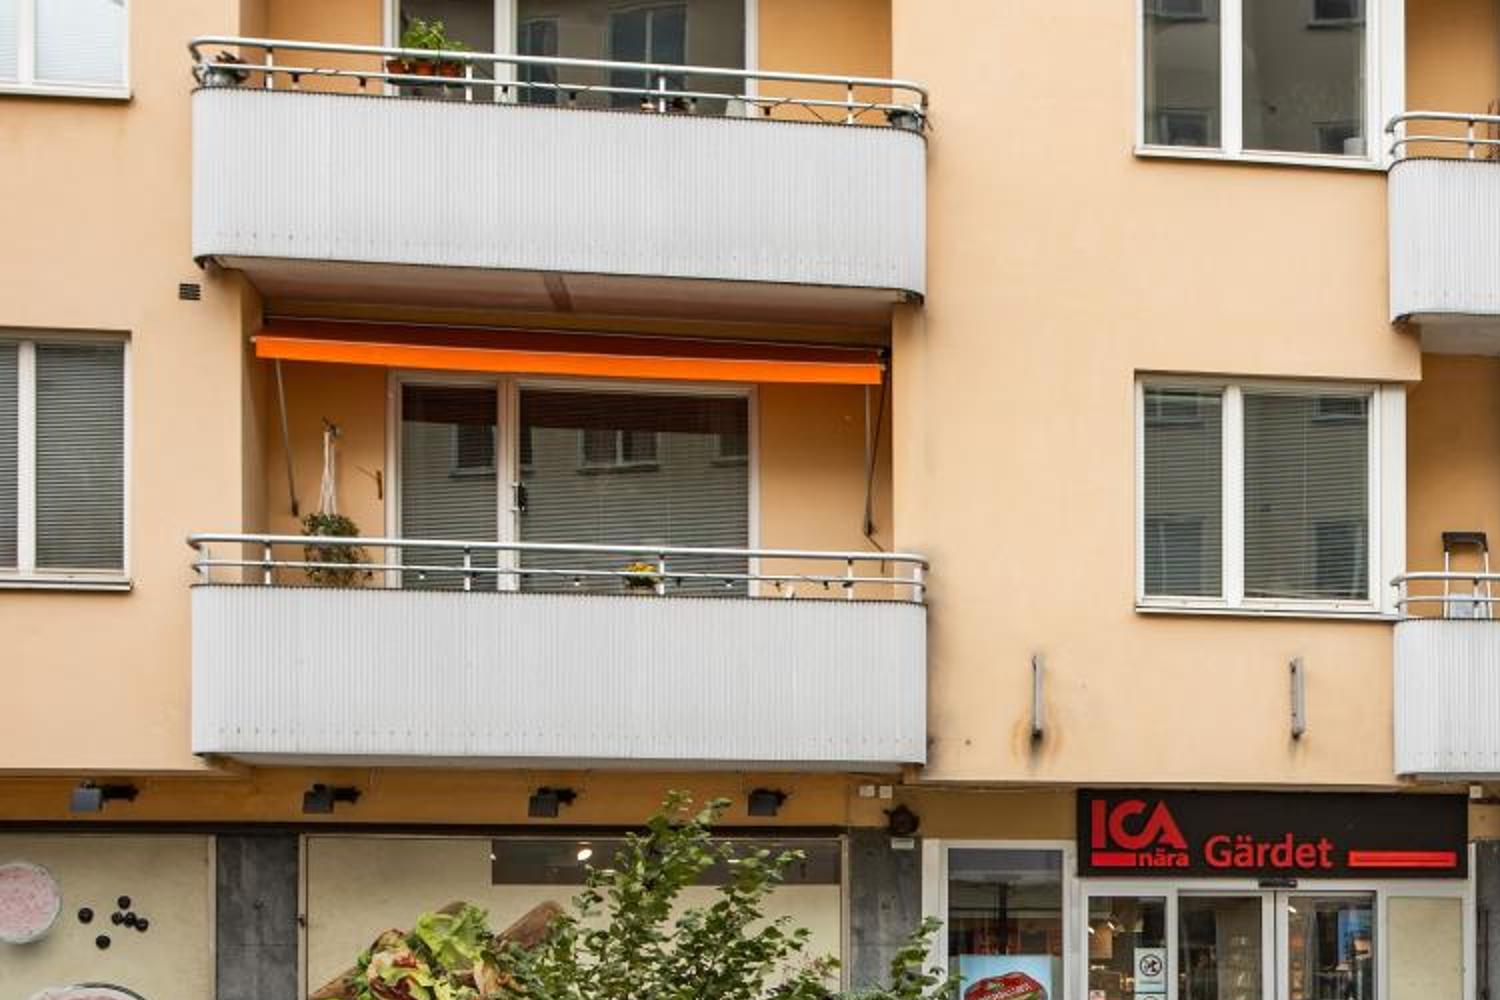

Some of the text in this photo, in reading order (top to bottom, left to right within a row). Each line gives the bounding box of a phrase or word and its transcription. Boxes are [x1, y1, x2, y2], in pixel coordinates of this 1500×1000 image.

[1091, 799, 1188, 850] ICA
[1138, 849, 1190, 867] nära
[1204, 832, 1334, 869] Gärdet
